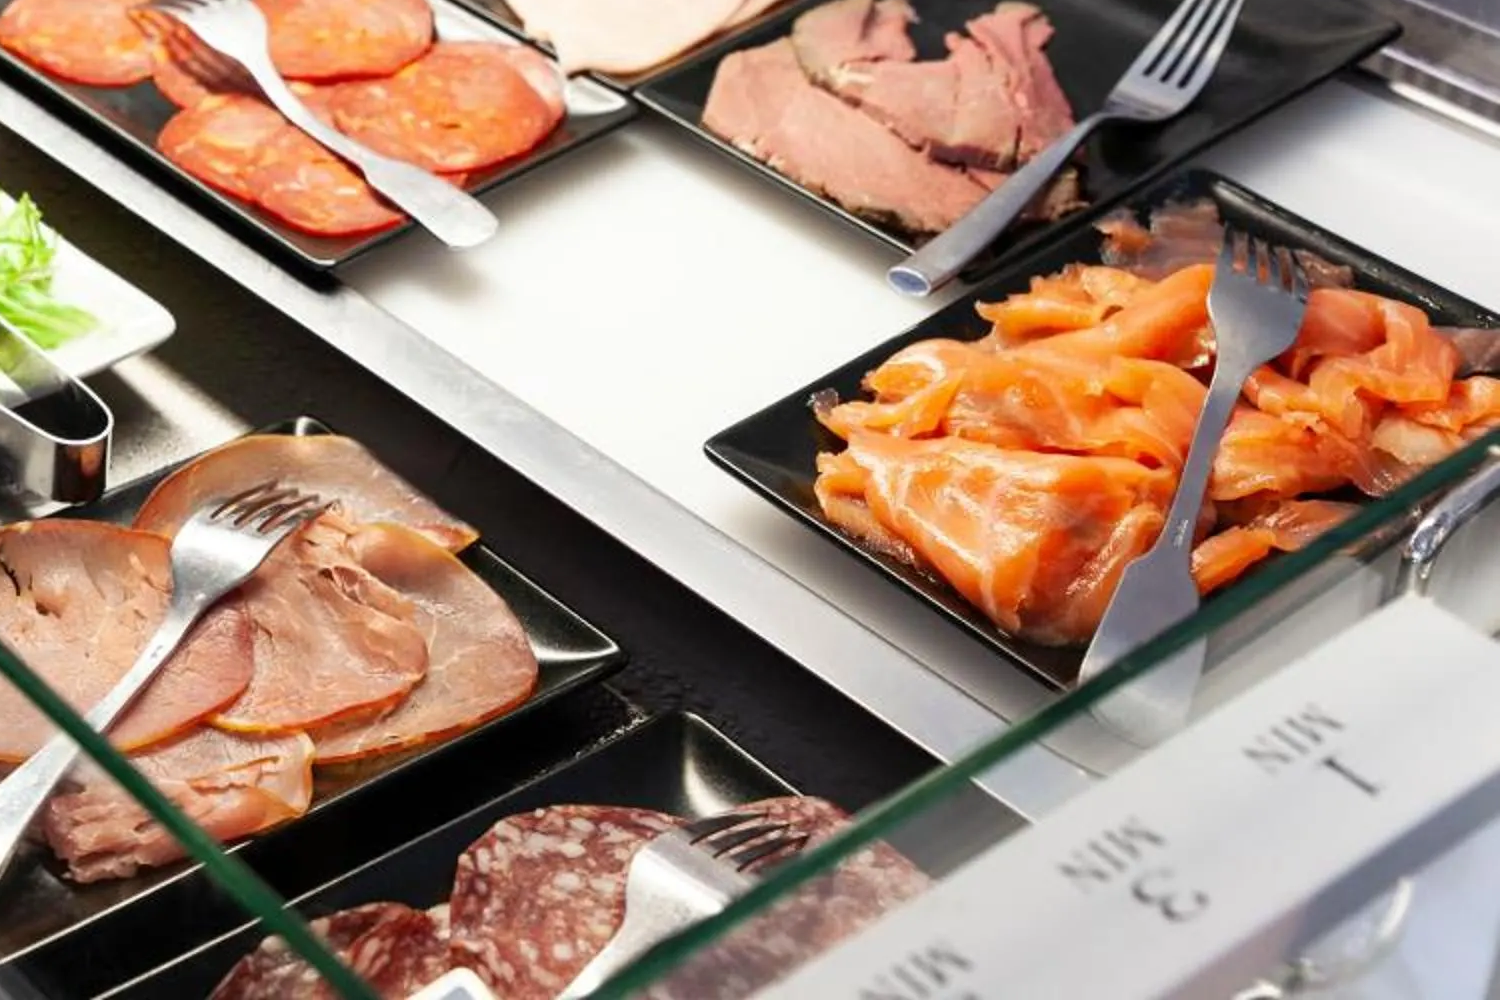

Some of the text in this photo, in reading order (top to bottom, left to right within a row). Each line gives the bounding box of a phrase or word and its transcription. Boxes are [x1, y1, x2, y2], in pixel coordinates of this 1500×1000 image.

[1243, 704, 1345, 775] MIN
[1316, 755, 1383, 798] 1
[1058, 817, 1165, 893] MIN
[1131, 868, 1208, 923] 3
